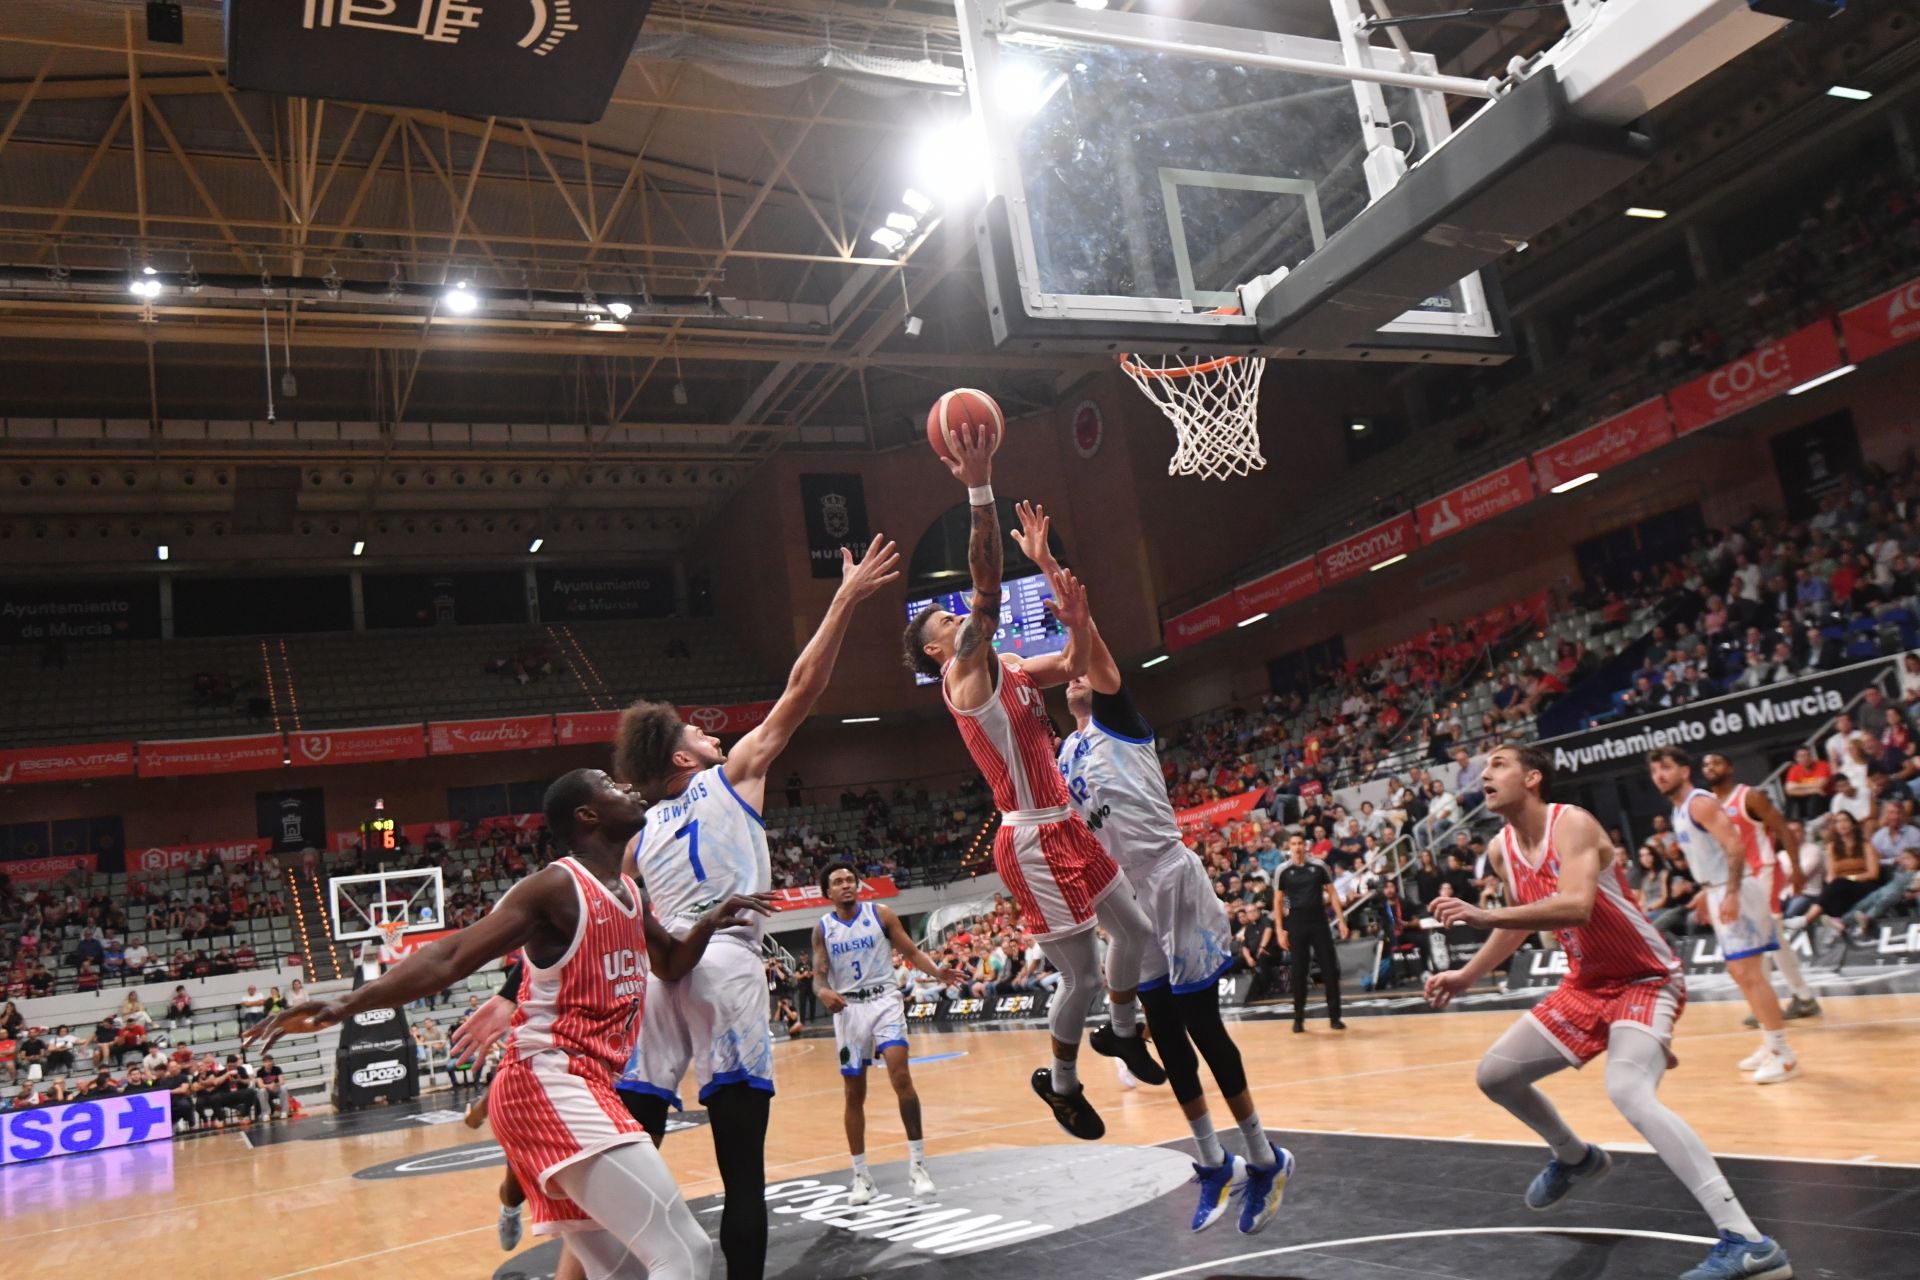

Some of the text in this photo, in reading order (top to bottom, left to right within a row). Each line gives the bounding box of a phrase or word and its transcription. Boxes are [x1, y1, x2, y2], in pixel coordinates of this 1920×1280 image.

[1327, 526, 1403, 571] setcomur
[553, 580, 650, 593] Ayuntamiento
[2, 600, 129, 617] Ayuntamiento
[21, 621, 112, 638] de Murcia
[1554, 686, 1843, 771] Ayuntamiento de Murcia
[19, 752, 129, 770] IBERIA VITAE
[165, 751, 221, 763] ESTRELLA
[383, 830, 395, 848] 6
[675, 819, 706, 882] 7
[832, 936, 875, 955] RILSKI
[851, 961, 862, 981] 3
